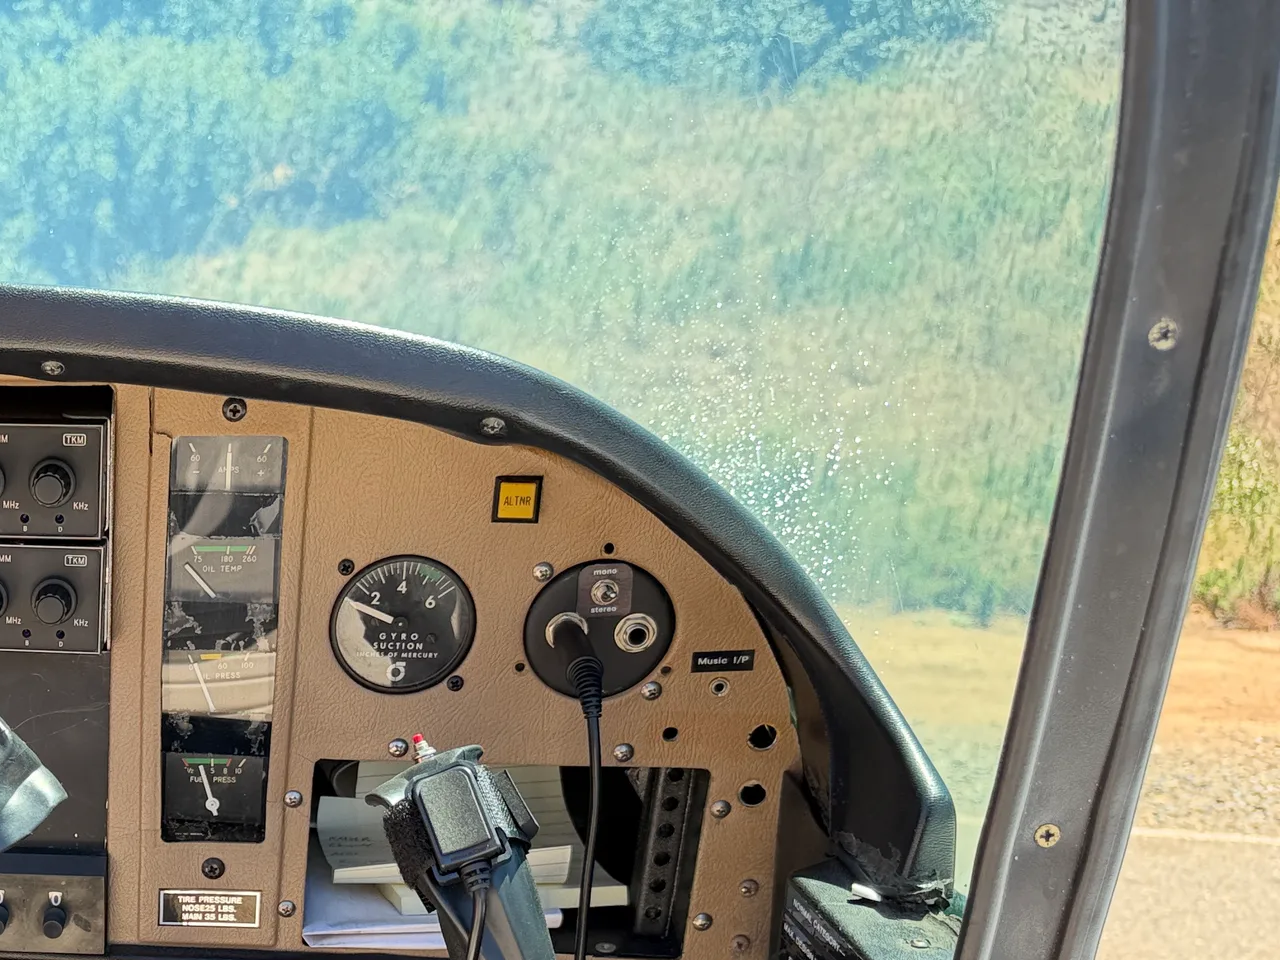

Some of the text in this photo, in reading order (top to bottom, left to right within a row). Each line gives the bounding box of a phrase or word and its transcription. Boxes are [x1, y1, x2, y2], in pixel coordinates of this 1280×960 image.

[66, 435, 84, 445] TKM
[2, 500, 20, 510] MHz
[73, 501, 89, 510] KHz
[503, 496, 531, 507] ALTNR
[593, 568, 617, 576] mono
[590, 605, 617, 614] stereo
[372, 641, 424, 652] SUCTION
[698, 656, 749, 667] Music I/P
[178, 896, 242, 904] TIRE PRESSURE
[182, 913, 237, 922] MAIN 35 LBS.
